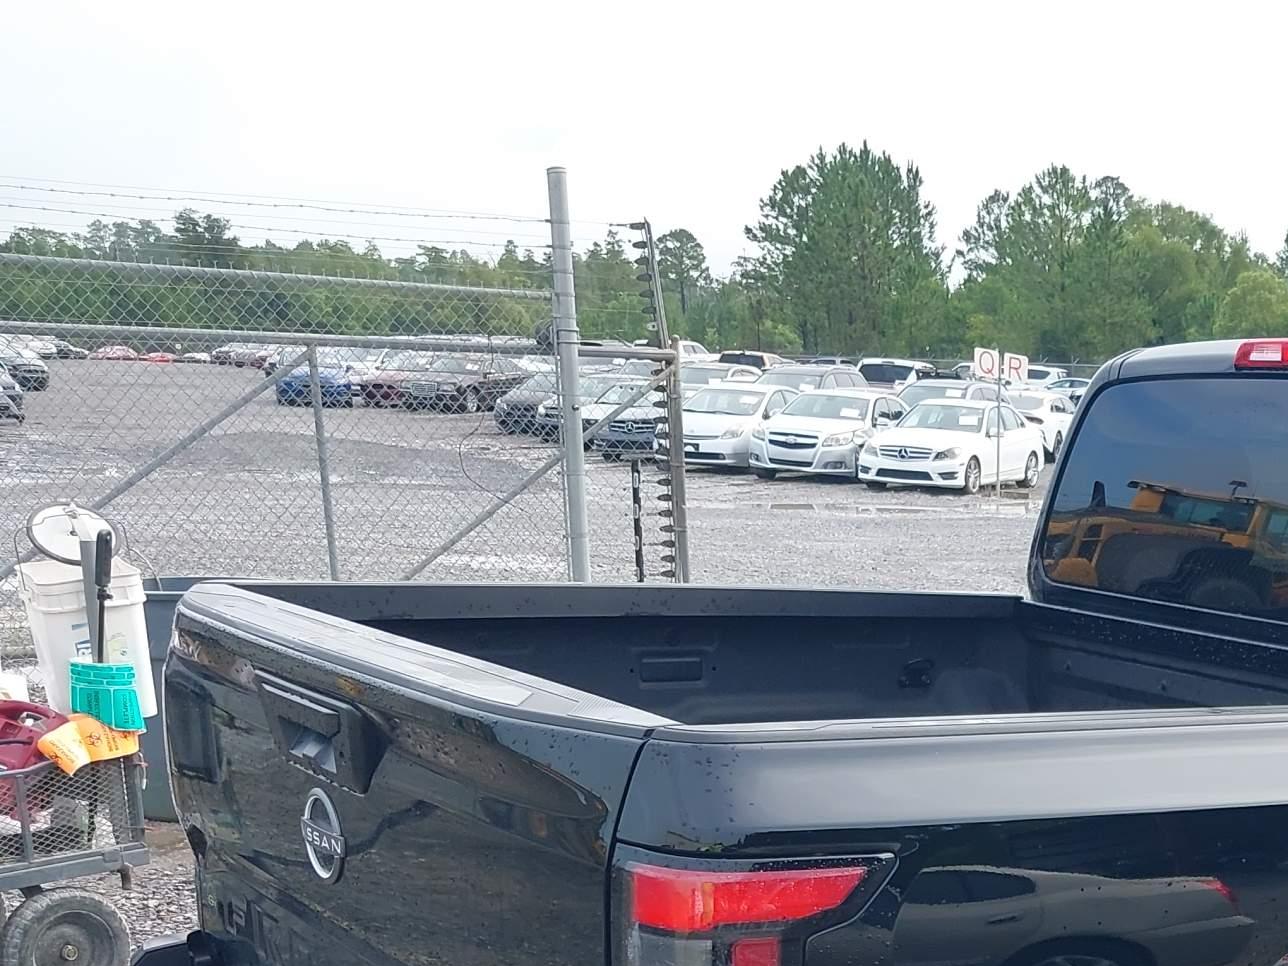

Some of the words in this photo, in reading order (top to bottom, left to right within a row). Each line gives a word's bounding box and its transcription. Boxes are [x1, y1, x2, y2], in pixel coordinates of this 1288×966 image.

[979, 350, 995, 377] Q
[1008, 356, 1022, 381] R
[304, 825, 342, 854] SSAN
